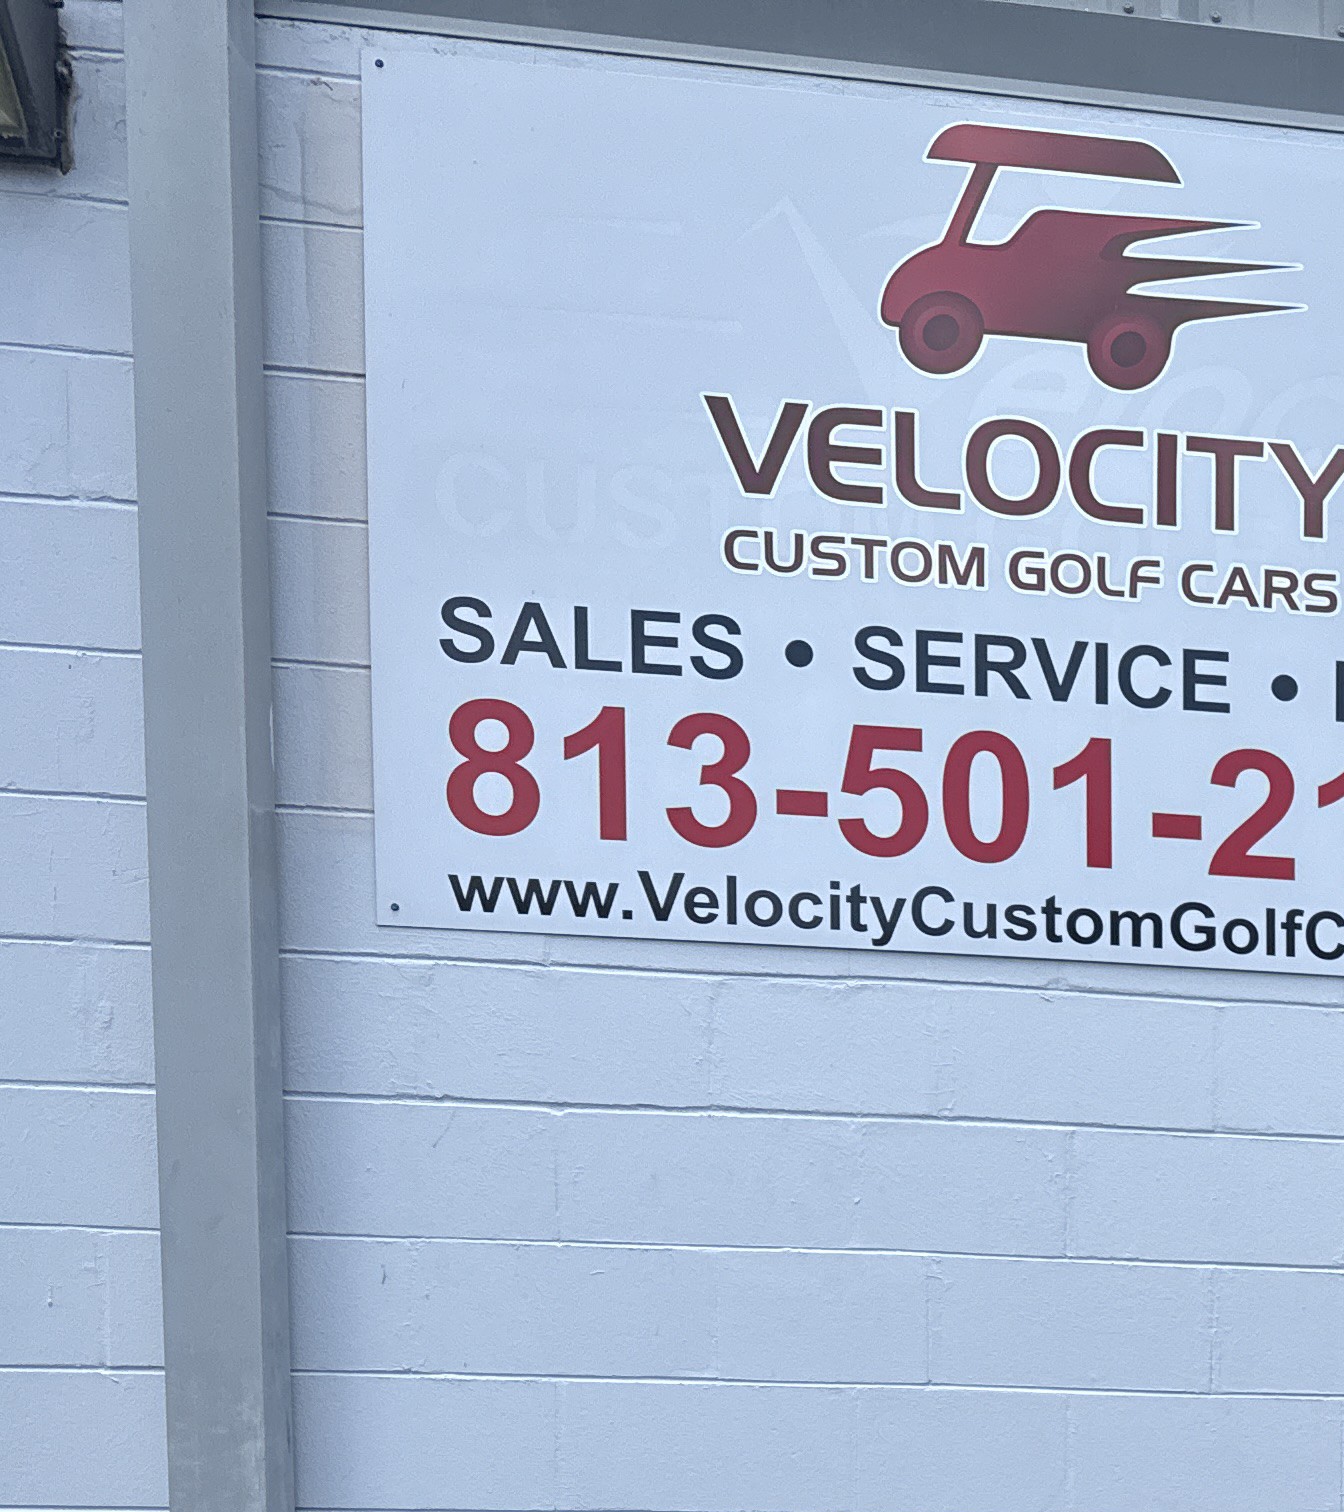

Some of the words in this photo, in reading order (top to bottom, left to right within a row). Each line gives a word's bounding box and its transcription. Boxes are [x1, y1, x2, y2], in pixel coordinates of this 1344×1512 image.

[724, 529, 985, 588] CUSTOM
[1008, 550, 1161, 599] GOLF
[1181, 563, 1338, 614] CARS
[439, 596, 744, 680] SALES
[852, 625, 1231, 714] SERVICE
